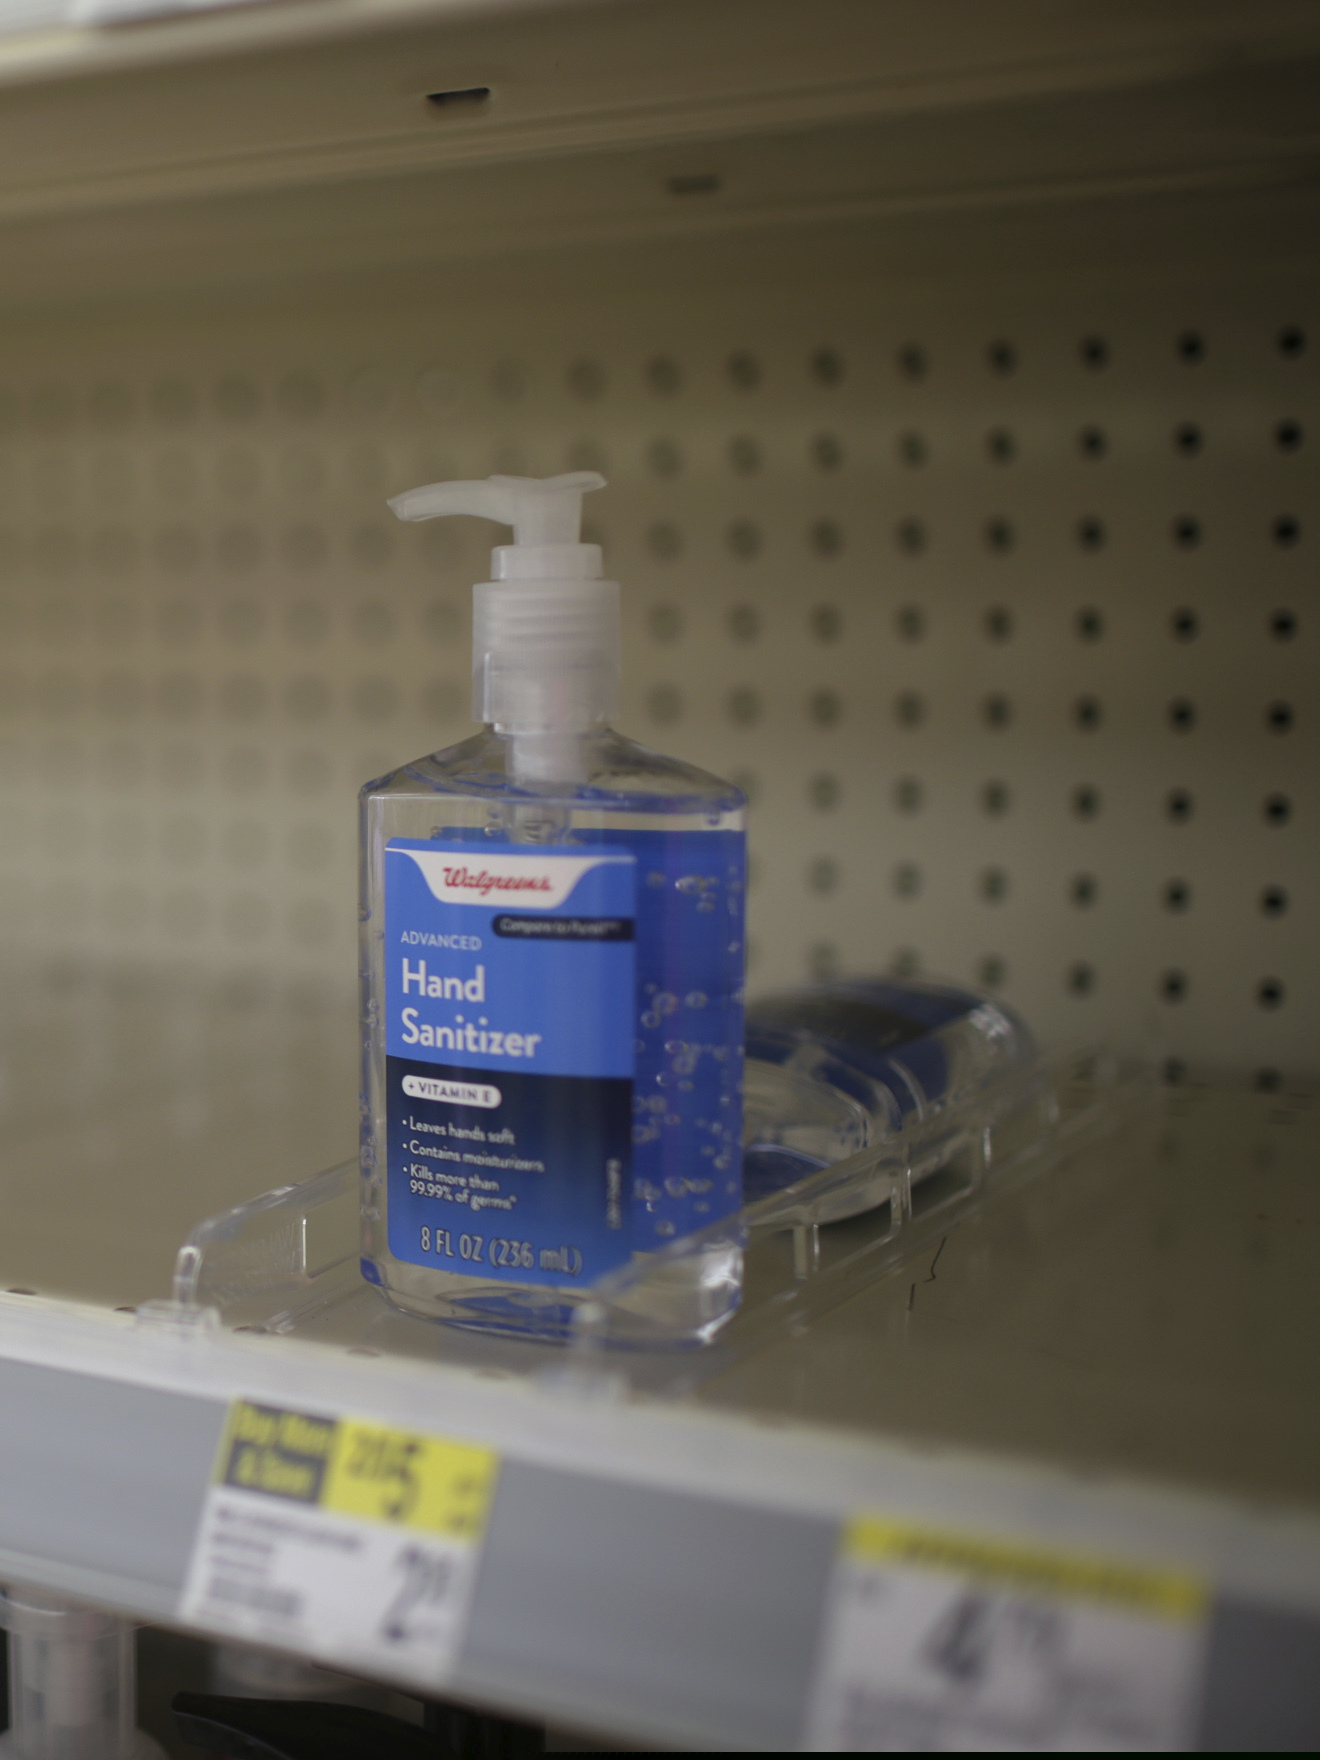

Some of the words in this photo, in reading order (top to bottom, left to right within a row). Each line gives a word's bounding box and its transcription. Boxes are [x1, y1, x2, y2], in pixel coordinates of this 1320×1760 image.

[443, 867, 553, 896] Walgreens
[401, 930, 482, 951] ADVANCED
[402, 957, 485, 1003] Hand
[401, 1007, 542, 1058] Sanitizer
[419, 1081, 478, 1101] VITAMIN
[483, 1090, 492, 1103] E
[409, 1115, 447, 1136] Leaves
[448, 1122, 486, 1142] hands
[487, 1127, 516, 1146] soft
[409, 1139, 461, 1163] Contains
[462, 1150, 545, 1173] moisturizers
[410, 1163, 433, 1181] Kills
[435, 1172, 467, 1187] more
[469, 1174, 500, 1192] than
[410, 1179, 454, 1202] 99.99%
[455, 1188, 470, 1204] of
[420, 1226, 431, 1252] 8
[436, 1229, 454, 1257] FL
[459, 1234, 483, 1262] OZ
[488, 1237, 534, 1269] (236
